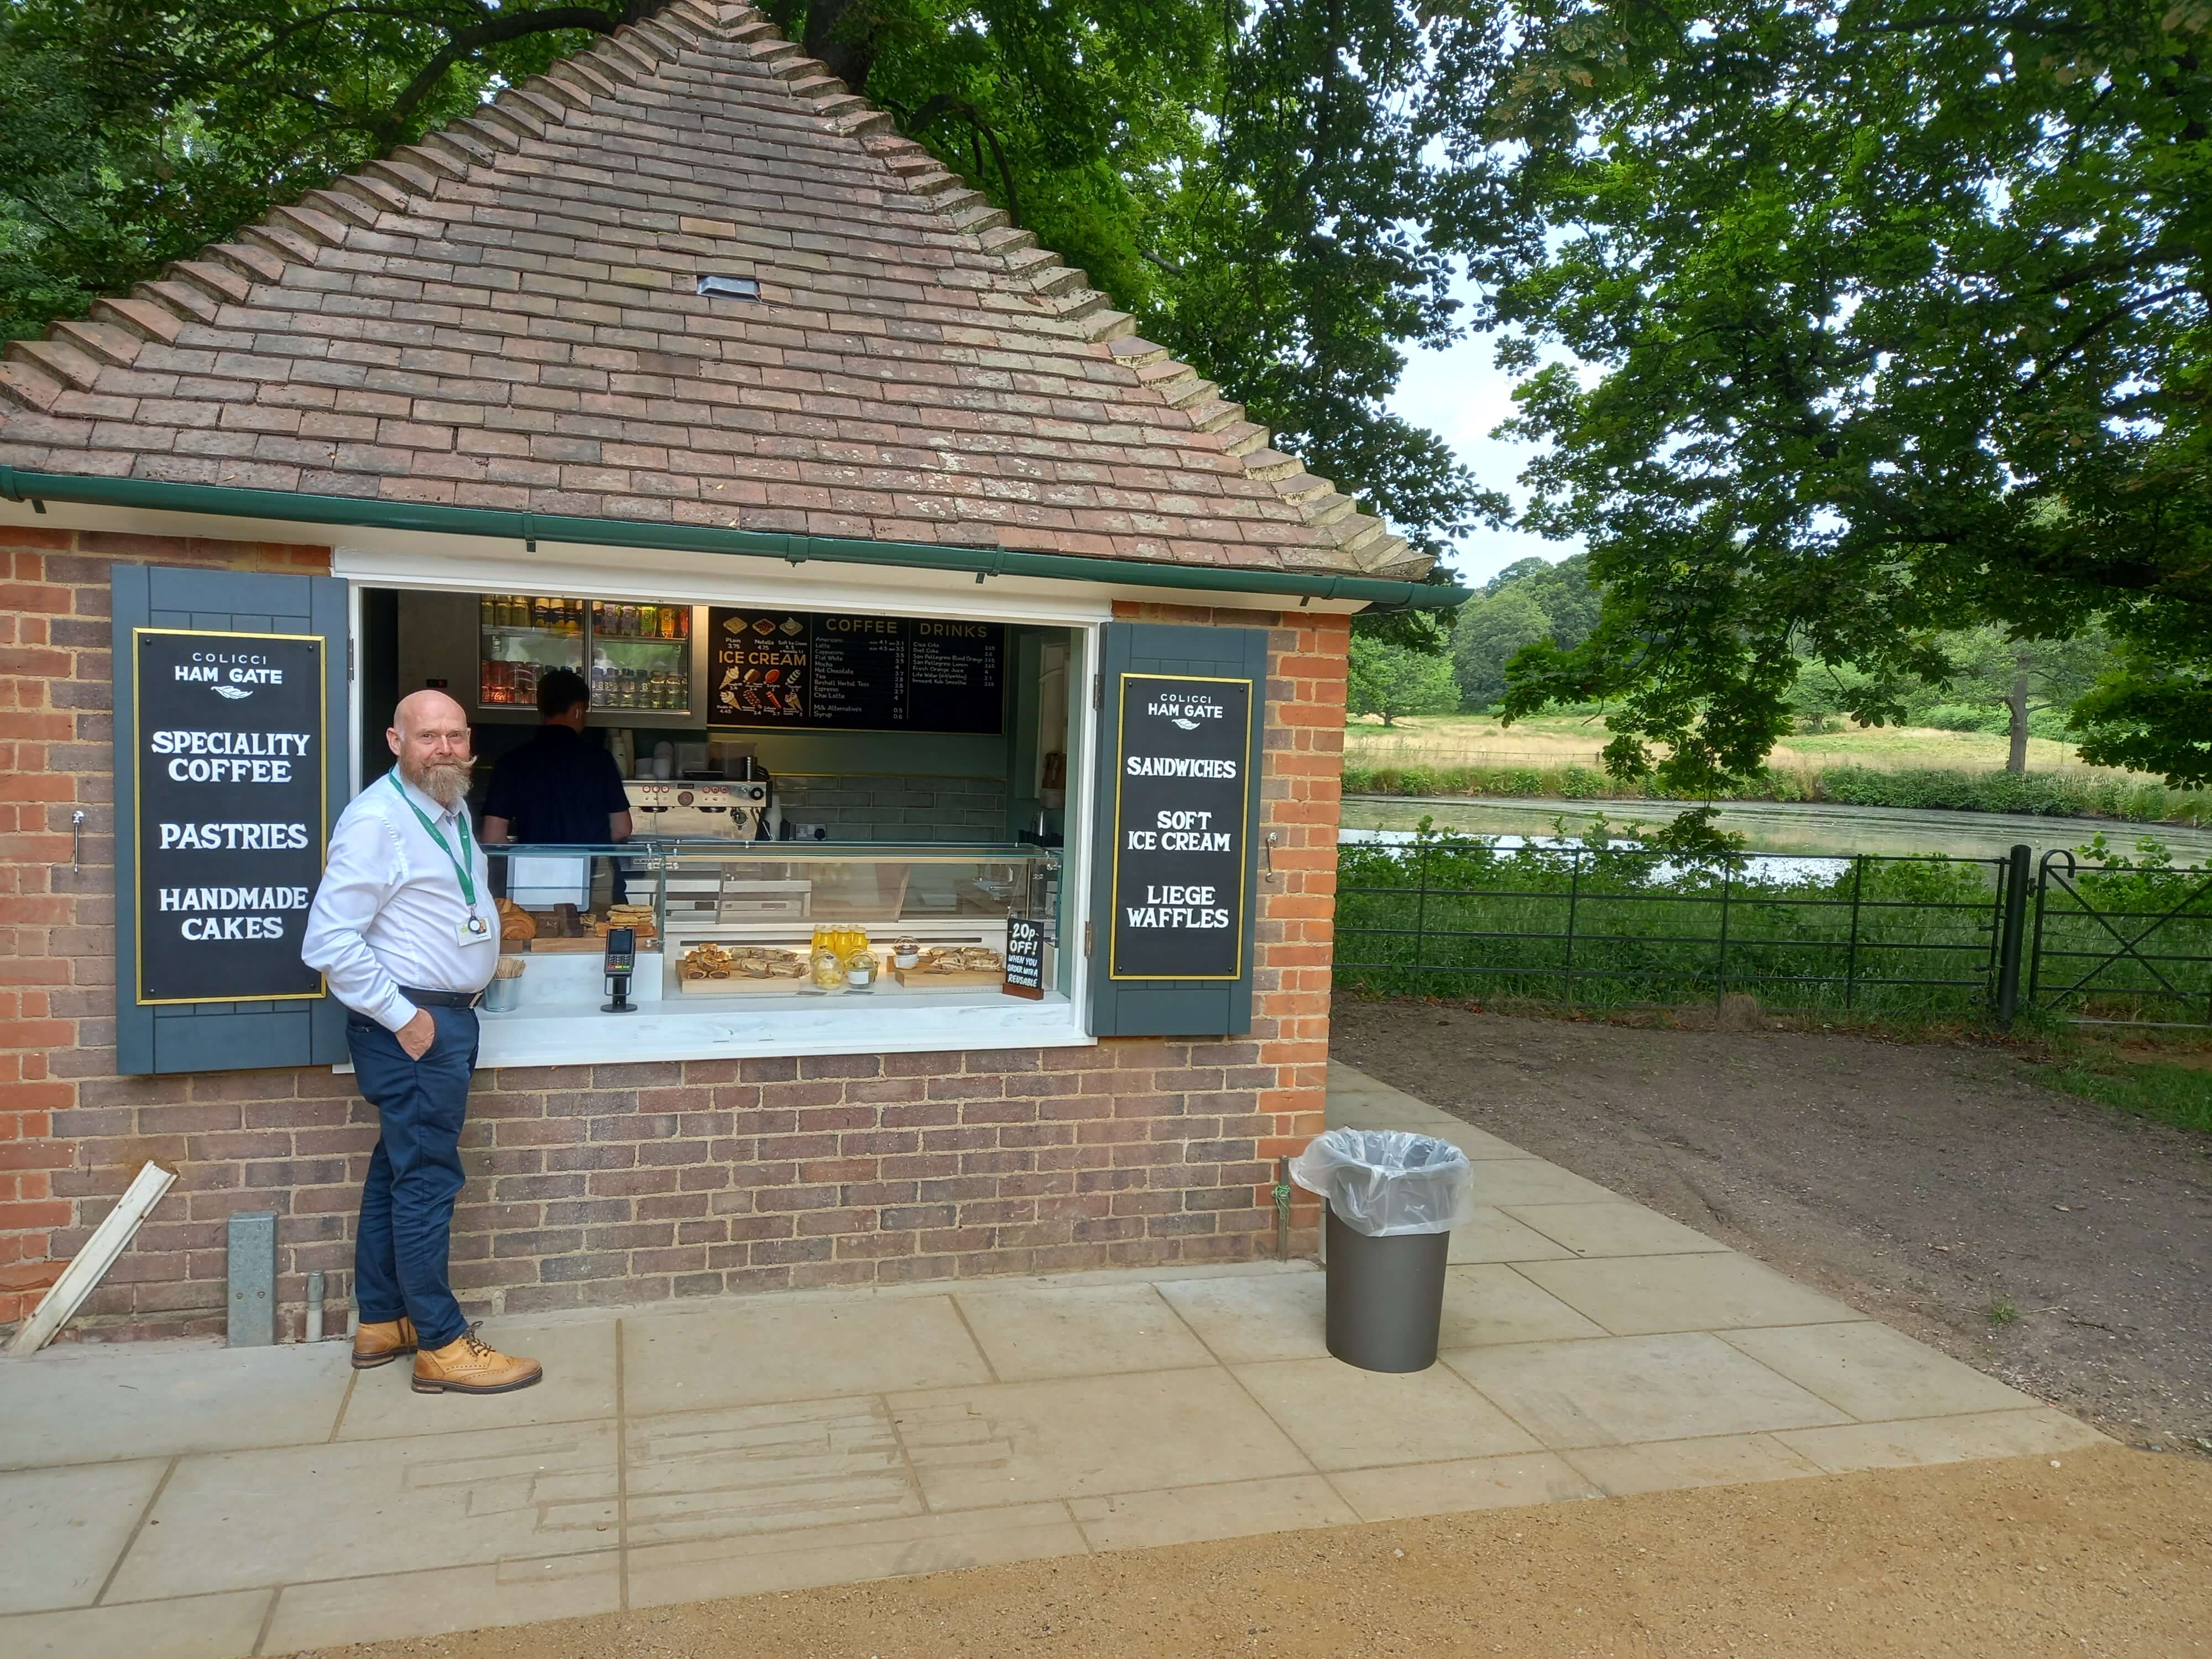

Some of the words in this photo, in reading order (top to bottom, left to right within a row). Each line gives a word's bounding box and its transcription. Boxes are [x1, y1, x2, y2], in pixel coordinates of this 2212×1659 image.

[826, 618, 898, 634] COFFEE
[920, 623, 988, 638] DRINKS
[192, 652, 268, 665] COLICCI
[718, 650, 744, 664] ICE
[748, 651, 806, 666] CREAM
[175, 666, 218, 682] HAM
[229, 668, 283, 685] GATE
[1160, 693, 1212, 704] COLICCI
[813, 711, 832, 719] Syrup
[1148, 703, 1180, 717] HAM
[1185, 704, 1223, 718] GATE
[152, 731, 311, 757] SPECIALITY
[168, 758, 292, 783] COFFEE
[1127, 756, 1237, 779] SANDWICHES
[1157, 810, 1212, 830] SOFT
[159, 823, 309, 850] PASTRIES
[1127, 831, 1157, 851] ICE
[1161, 832, 1231, 852] CREAM
[159, 886, 309, 912] HANDMADE
[1146, 885, 1216, 905] LIEGE
[1126, 907, 1229, 929] WAFFLES
[181, 915, 284, 941] CAKES
[1010, 940, 1037, 956] OFF!
[1008, 954, 1025, 964] WHEN
[1025, 957, 1037, 967] YOU
[1007, 964, 1022, 974] ORDER
[1034, 968, 1038, 978] A
[1008, 973, 1038, 988] REUSABLE
